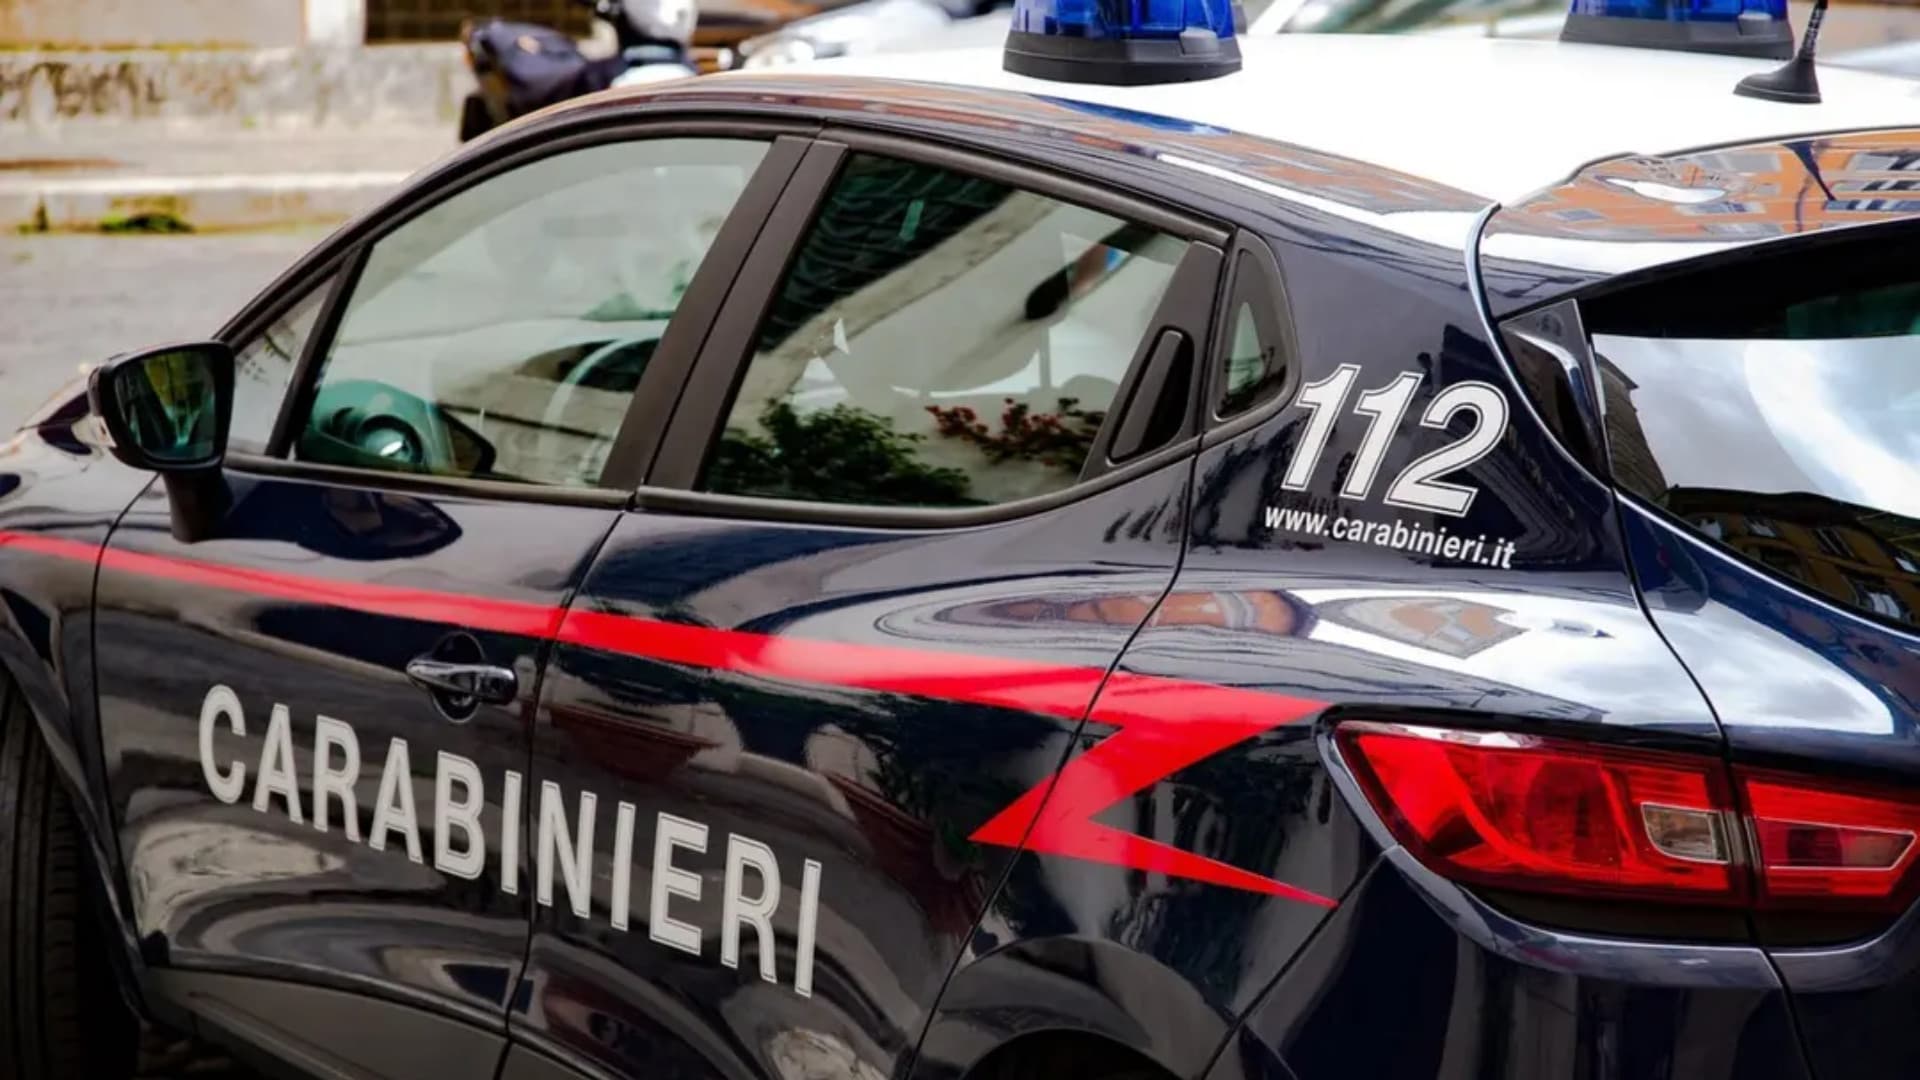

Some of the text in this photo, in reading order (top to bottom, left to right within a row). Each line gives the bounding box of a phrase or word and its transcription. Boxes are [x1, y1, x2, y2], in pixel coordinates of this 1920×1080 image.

[1281, 363, 1509, 517] 112
[1264, 506, 1516, 569] www.carabinieri.it
[199, 684, 822, 998] CARABINIERI
